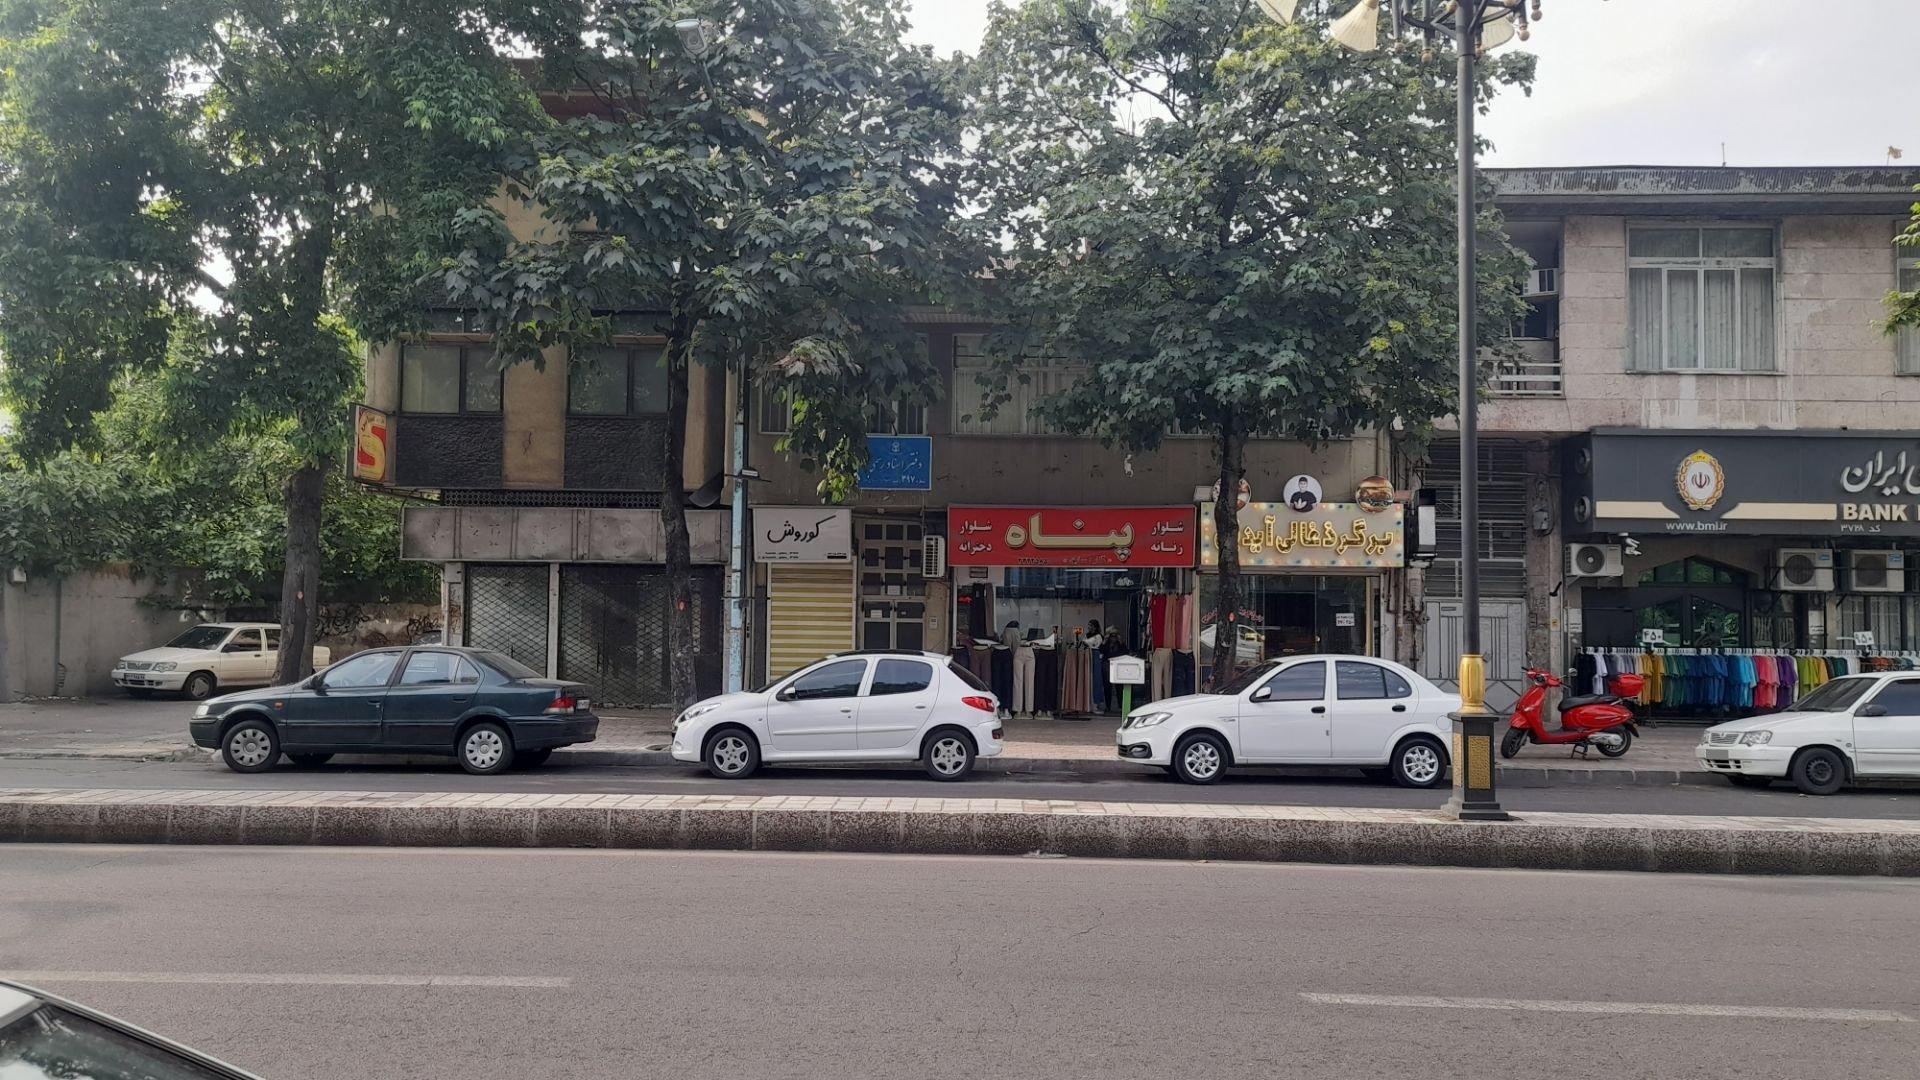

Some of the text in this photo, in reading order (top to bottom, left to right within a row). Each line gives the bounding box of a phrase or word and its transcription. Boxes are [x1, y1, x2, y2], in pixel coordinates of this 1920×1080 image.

[902, 451, 922, 472] دفتر
[901, 475, 915, 484] ۳۹۷
[1841, 450, 1906, 496] ایران
[1843, 503, 1908, 521] BANK
[766, 514, 837, 544] کوروش
[959, 519, 993, 535] شلوار
[1151, 520, 1185, 536] شلوار
[1665, 520, 1729, 531] www.bmi.ir
[1868, 524, 1881, 533] کد
[1004, 511, 1135, 562] پناه
[1213, 514, 1394, 555] برگر ذغالی آید
[959, 539, 993, 555] دخترانه
[1150, 540, 1184, 555] زنانه
